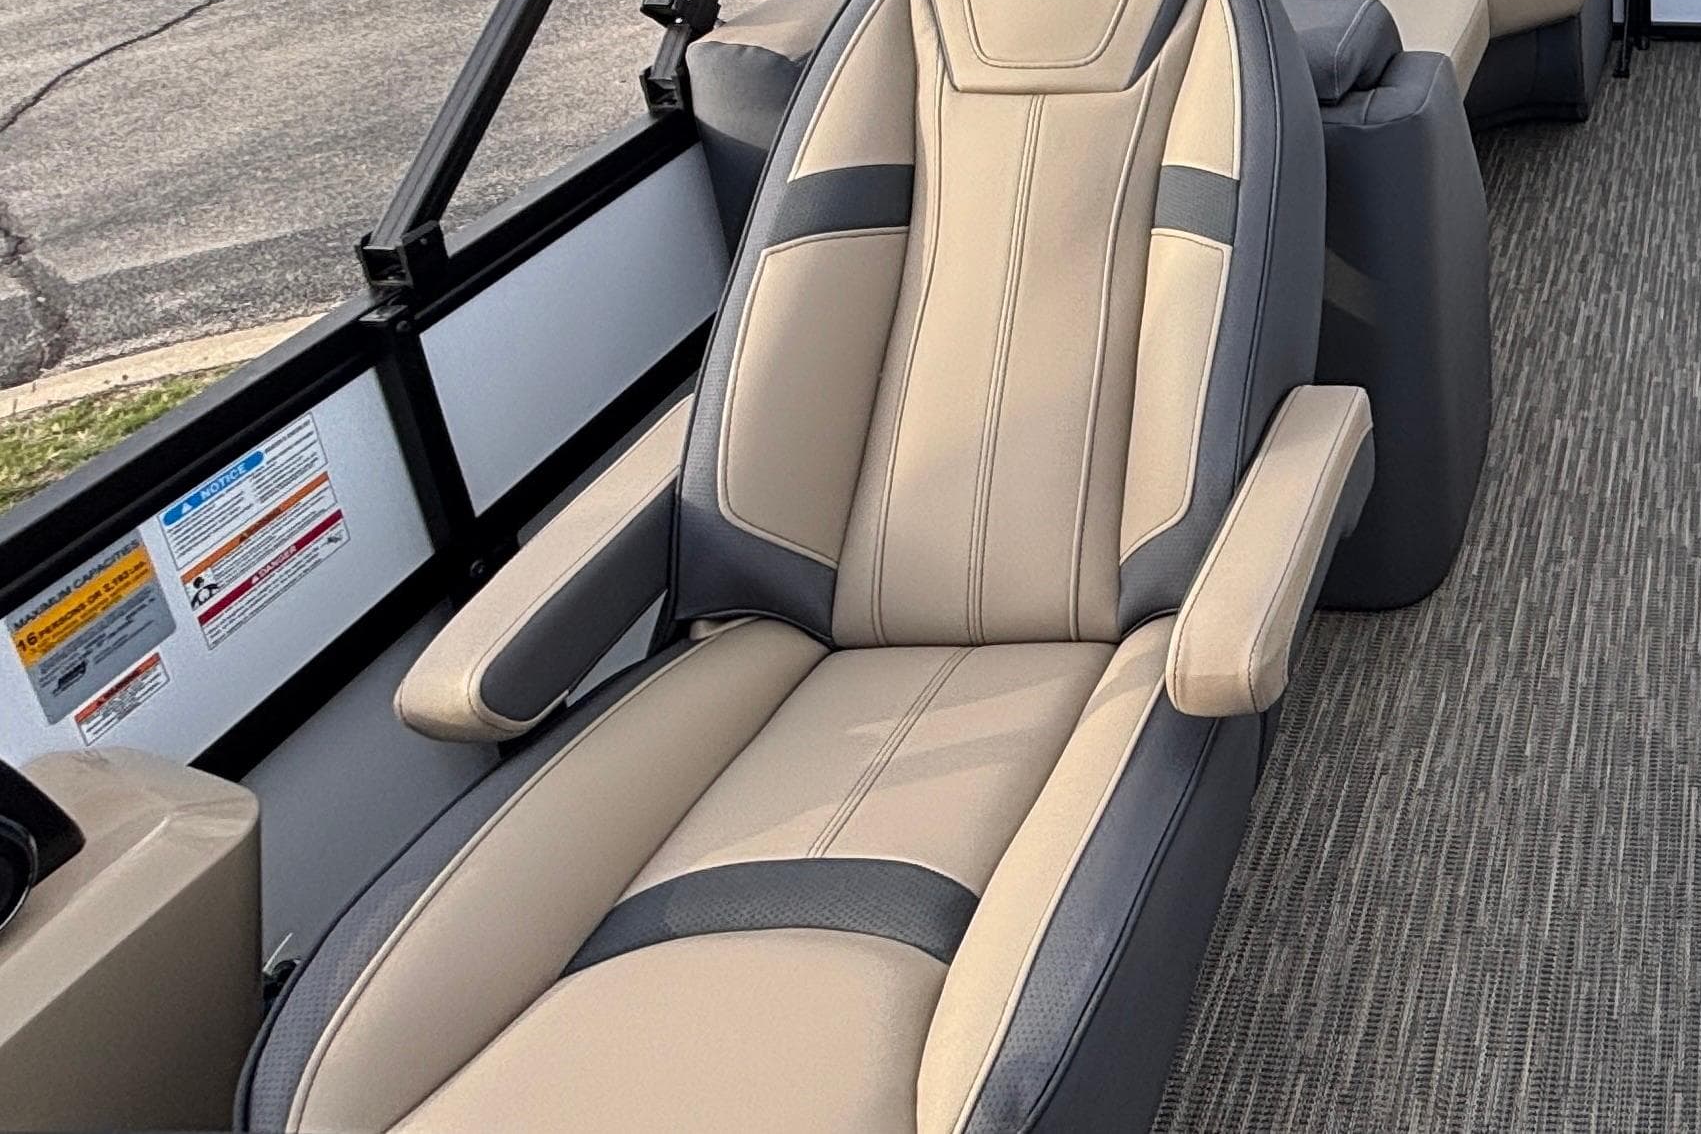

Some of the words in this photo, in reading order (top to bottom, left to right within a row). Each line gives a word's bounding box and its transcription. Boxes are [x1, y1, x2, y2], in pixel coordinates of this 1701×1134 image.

[201, 461, 248, 501] NOTICE
[258, 545, 298, 577] DANGER
[17, 632, 38, 652] 16
[38, 602, 86, 638] PERSONS
